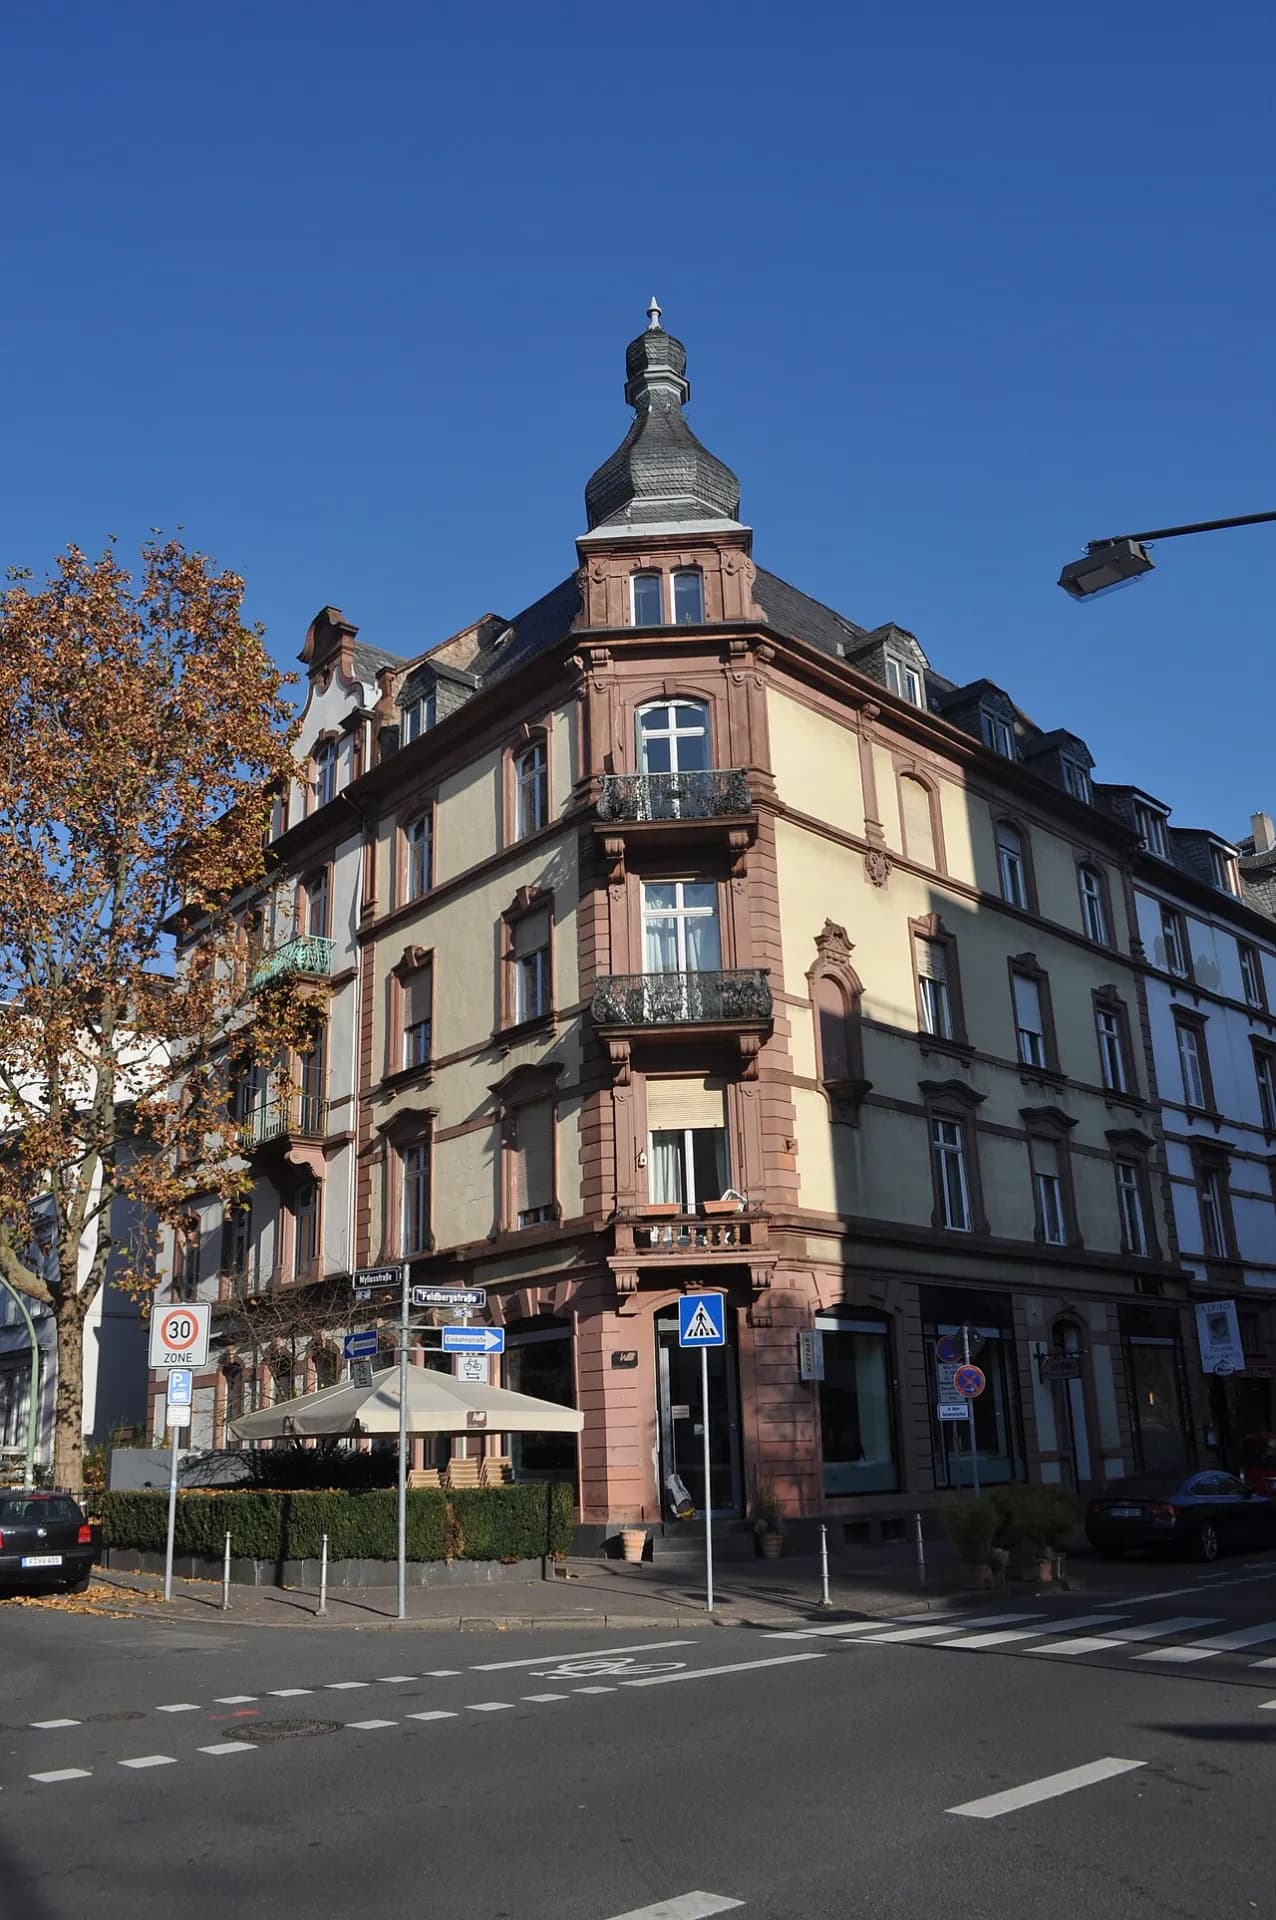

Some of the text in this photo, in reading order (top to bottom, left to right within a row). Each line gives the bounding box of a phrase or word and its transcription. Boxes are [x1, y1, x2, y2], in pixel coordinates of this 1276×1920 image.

[421, 1291, 477, 1303] Feldbergstraße
[168, 1320, 190, 1339] 30
[164, 1352, 193, 1363] ZONE
